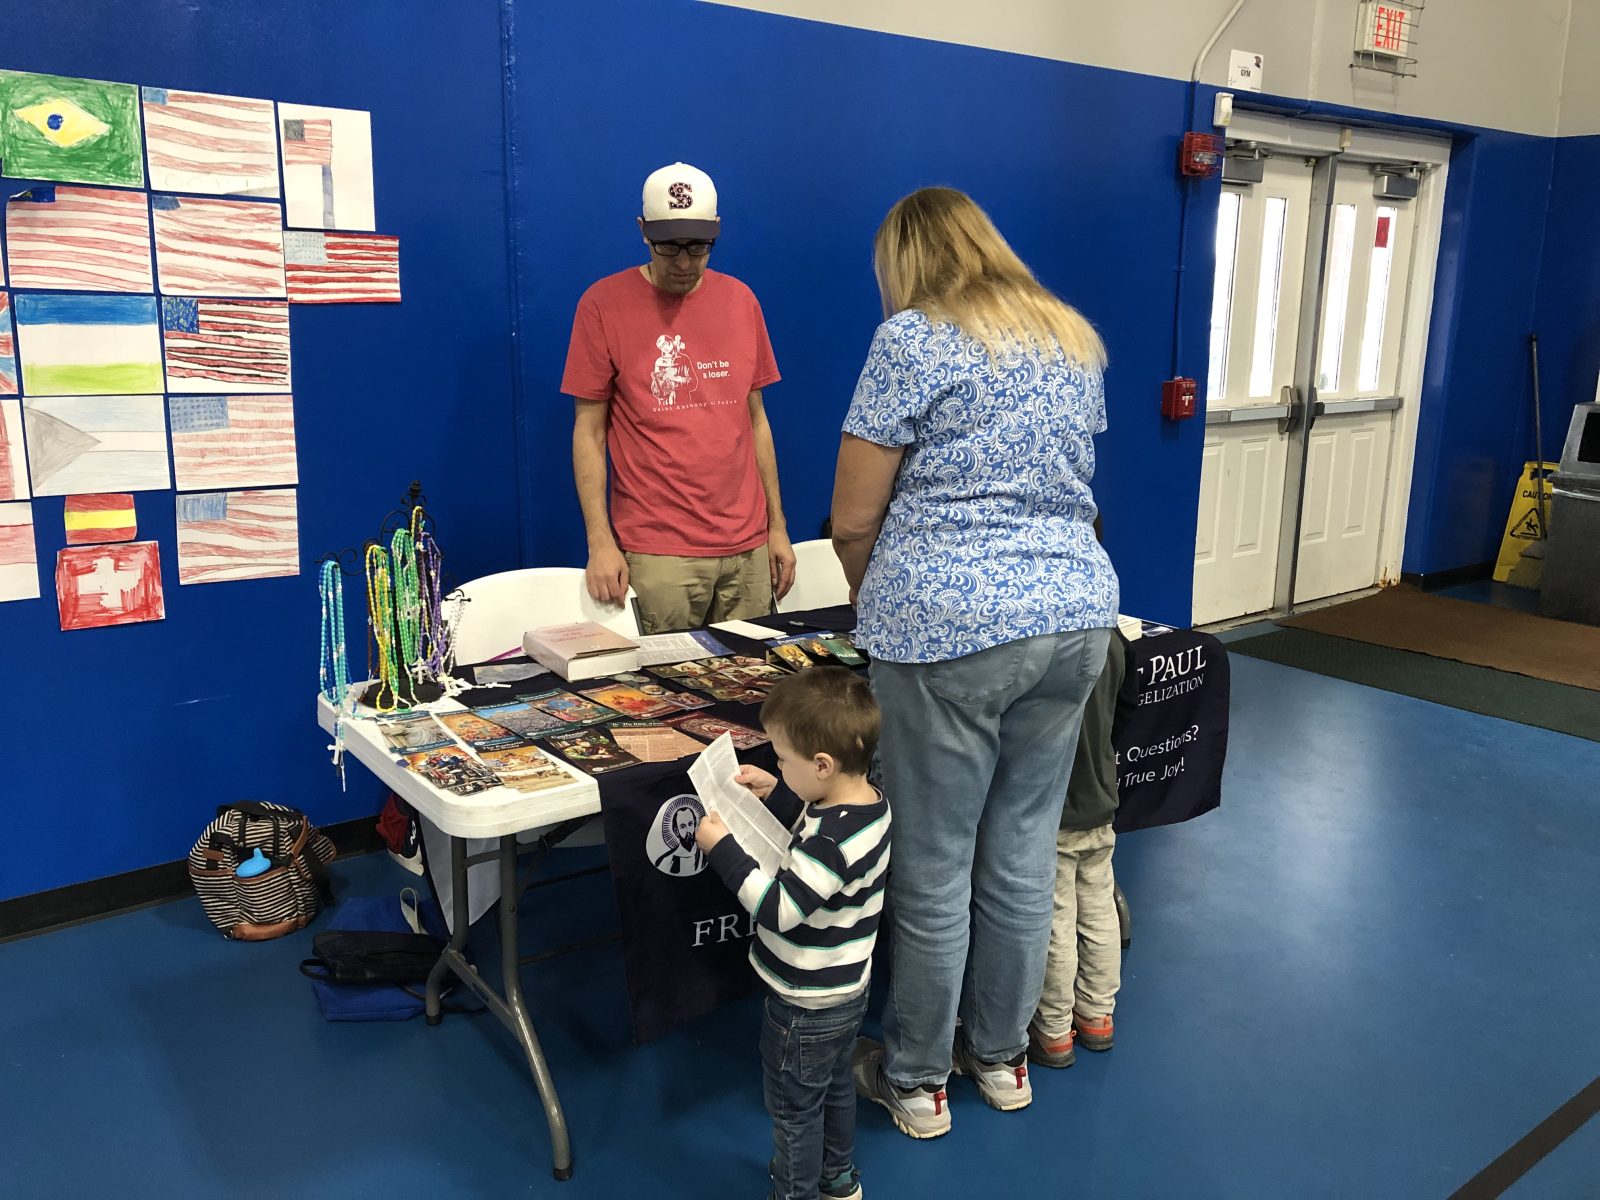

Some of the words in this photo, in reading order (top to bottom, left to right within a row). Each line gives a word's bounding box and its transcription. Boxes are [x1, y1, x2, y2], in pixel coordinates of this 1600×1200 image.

[1375, 6, 1405, 50] EXIT
[1240, 69, 1251, 77] GYM
[697, 360, 718, 370] Don't
[719, 360, 730, 368] be
[708, 370, 731, 379] loser.
[1523, 490, 1552, 500] CAUON
[1147, 645, 1207, 686] PAUL
[1126, 724, 1199, 762] Questions?
[1124, 771, 1156, 787] True
[1160, 756, 1185, 780] Joy!
